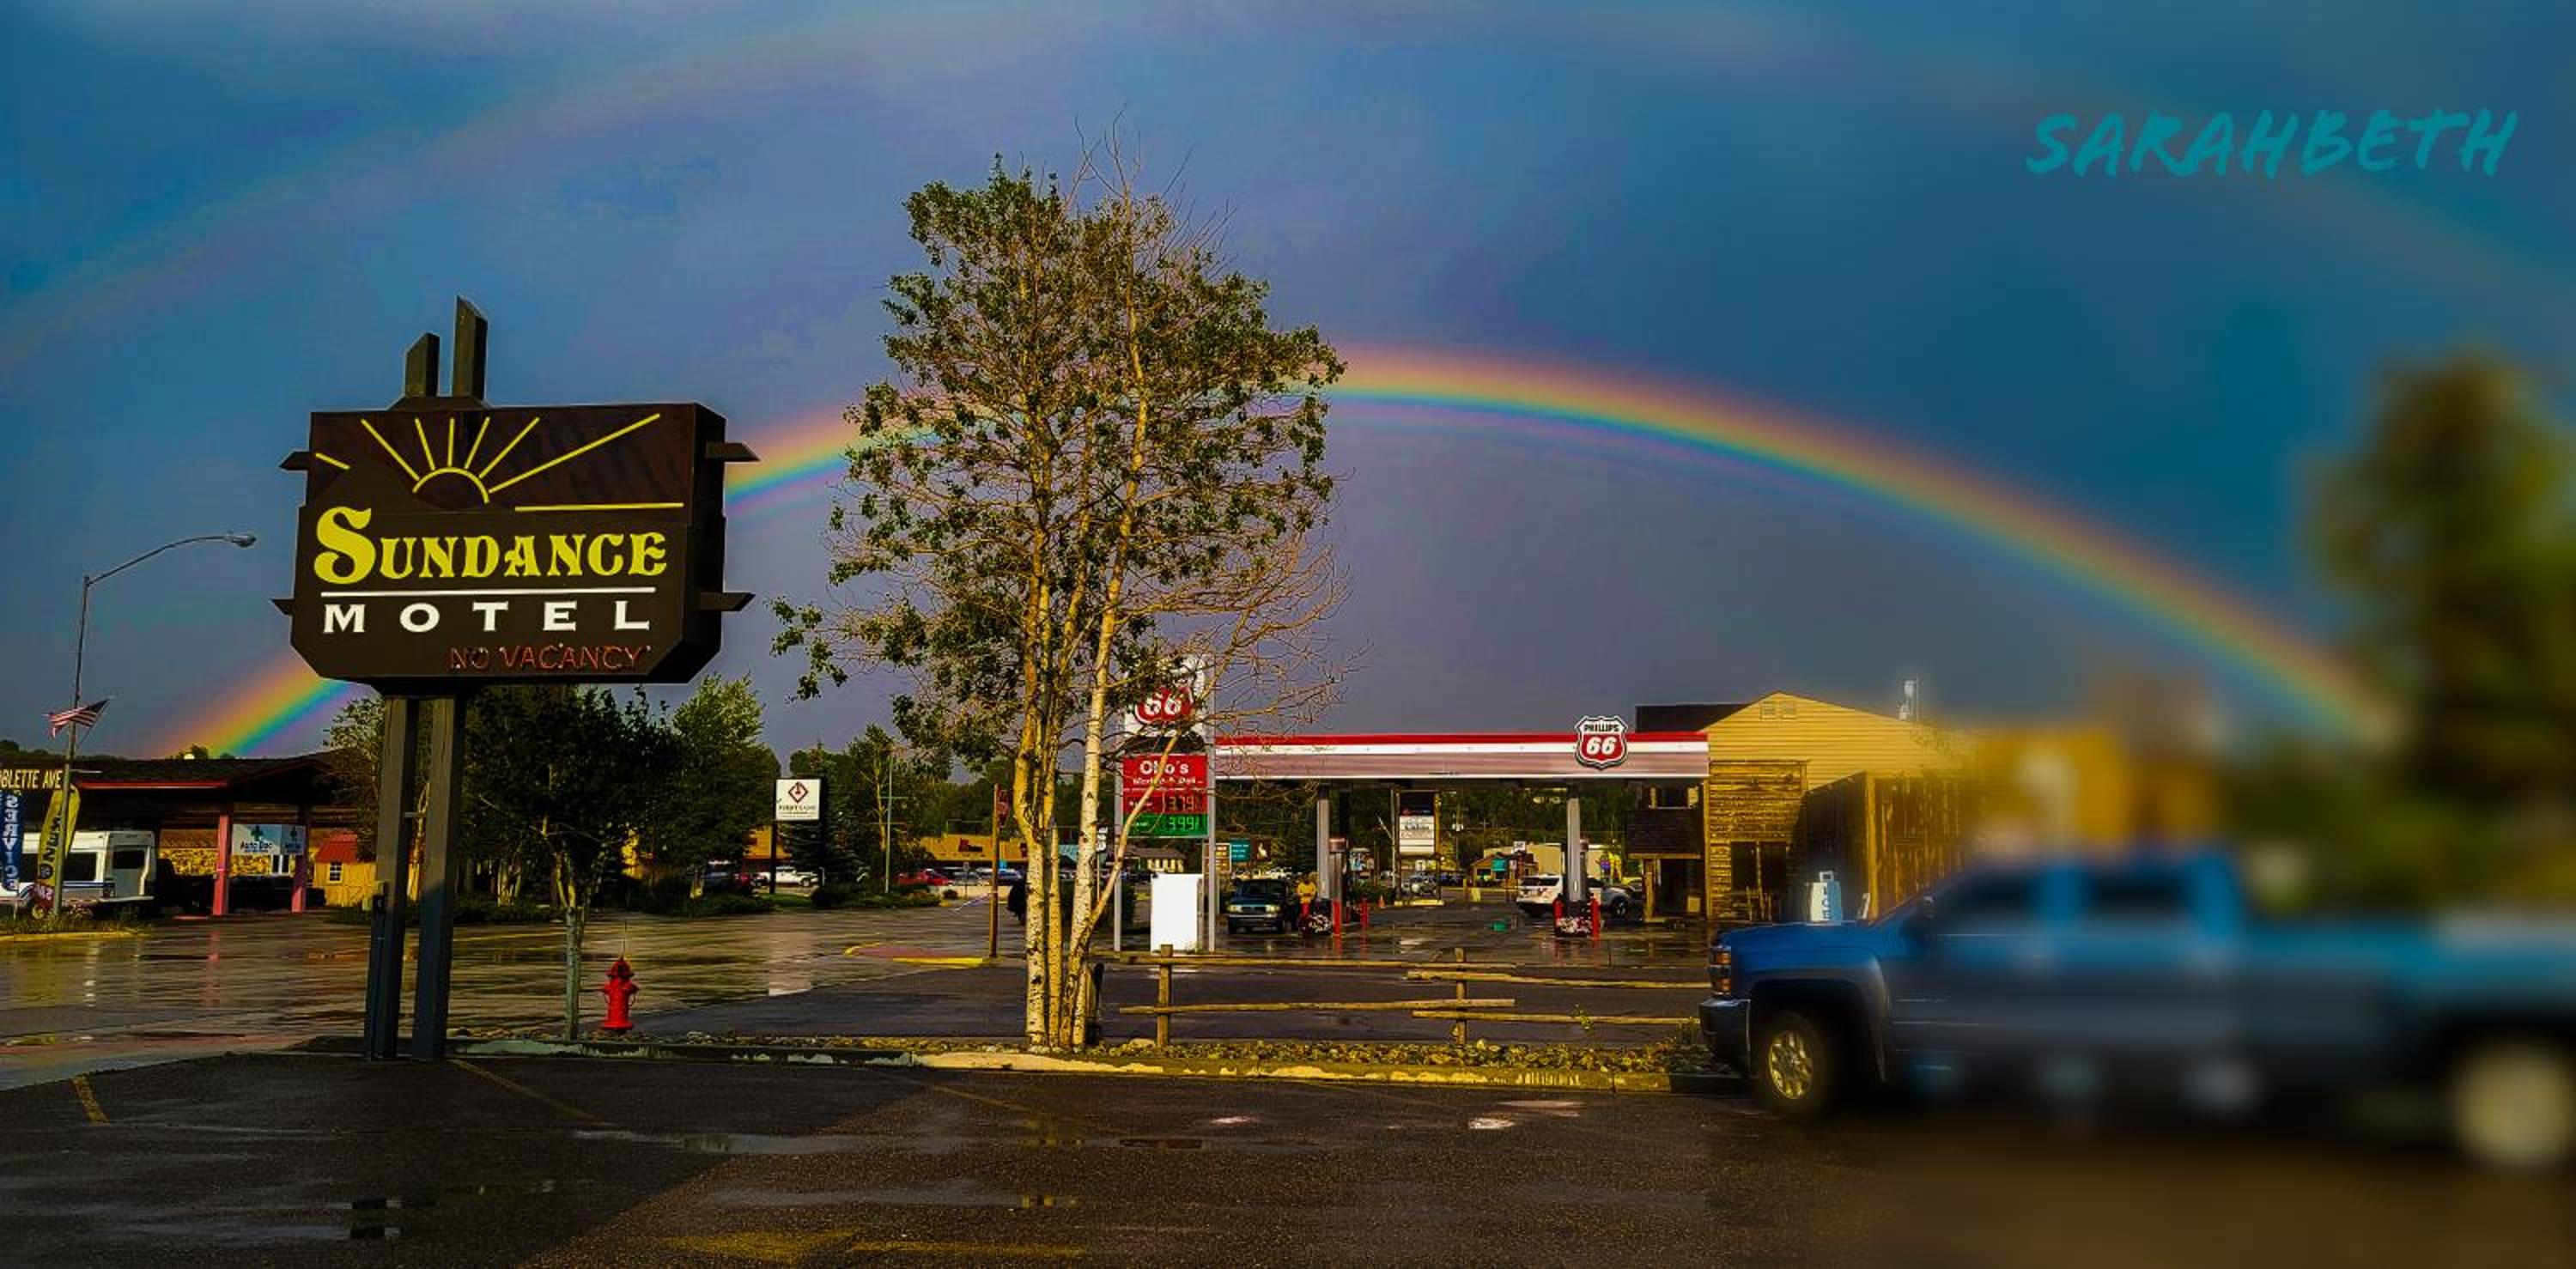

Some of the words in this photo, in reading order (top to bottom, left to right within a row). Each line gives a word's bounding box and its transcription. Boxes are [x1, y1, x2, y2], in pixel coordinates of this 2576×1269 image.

[323, 601, 650, 634] MOTEL
[451, 646, 489, 670] NO
[499, 645, 644, 670] VACANCY
[1586, 737, 1617, 755] 66
[42, 769, 64, 789] AVE
[1821, 886, 1831, 920] ICE
